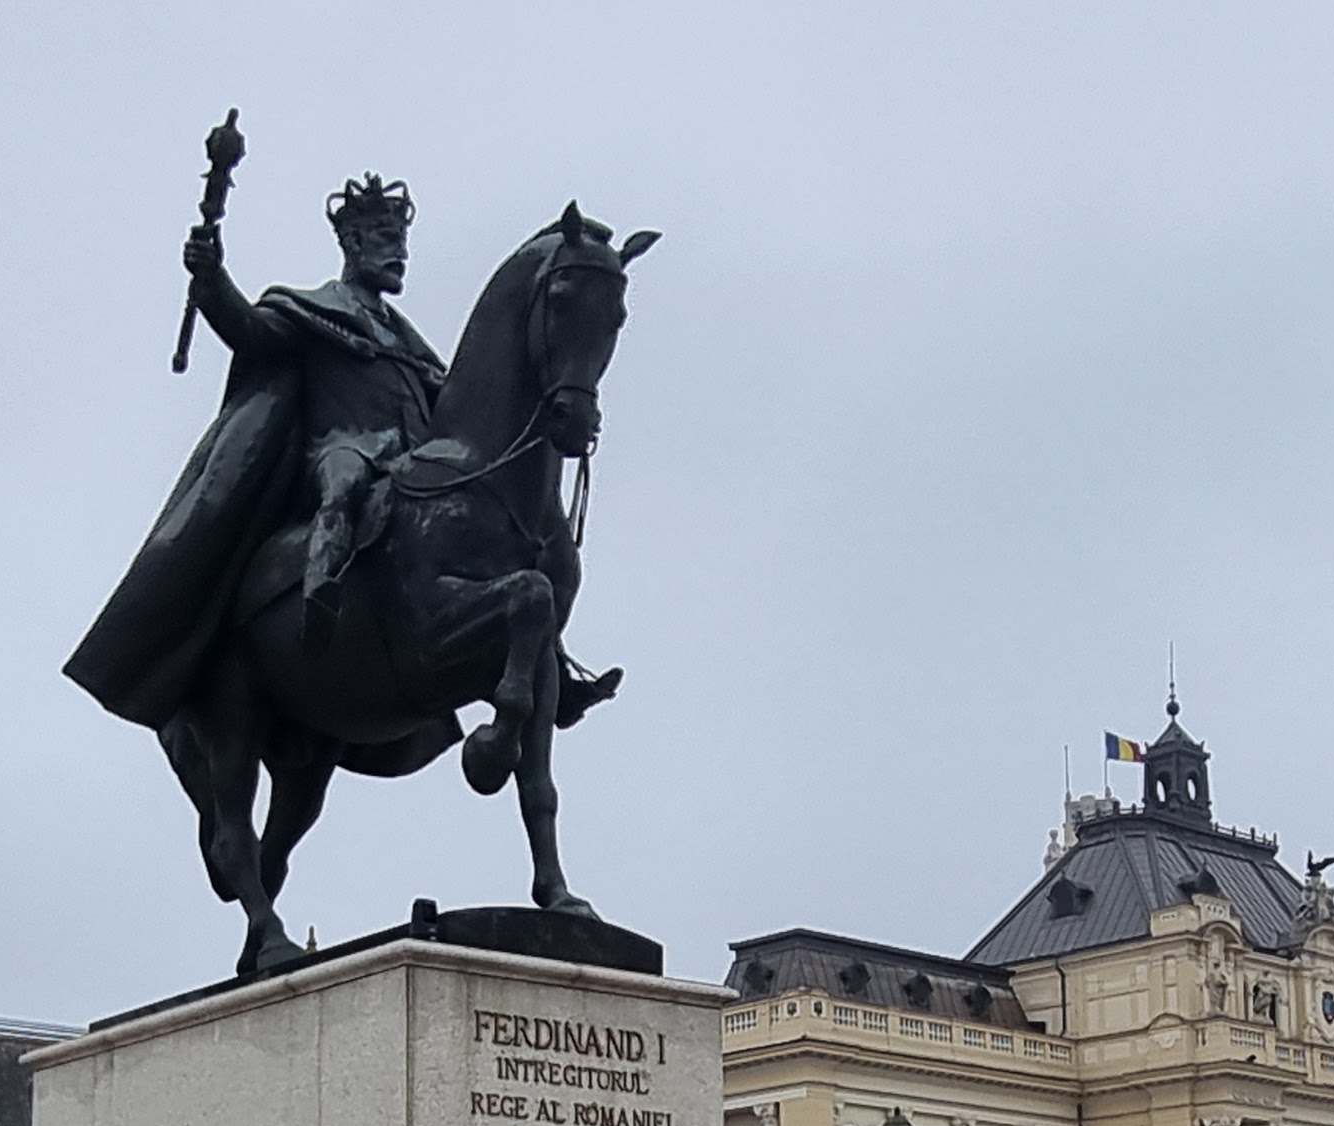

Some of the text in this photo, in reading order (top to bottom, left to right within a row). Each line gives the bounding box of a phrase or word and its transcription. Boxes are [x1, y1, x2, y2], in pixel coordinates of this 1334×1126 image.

[474, 1010, 667, 1065] FERDINAND I
[496, 1056, 649, 1095] INTREGITORUL
[470, 1091, 529, 1120] REGE
[536, 1098, 566, 1124] AL
